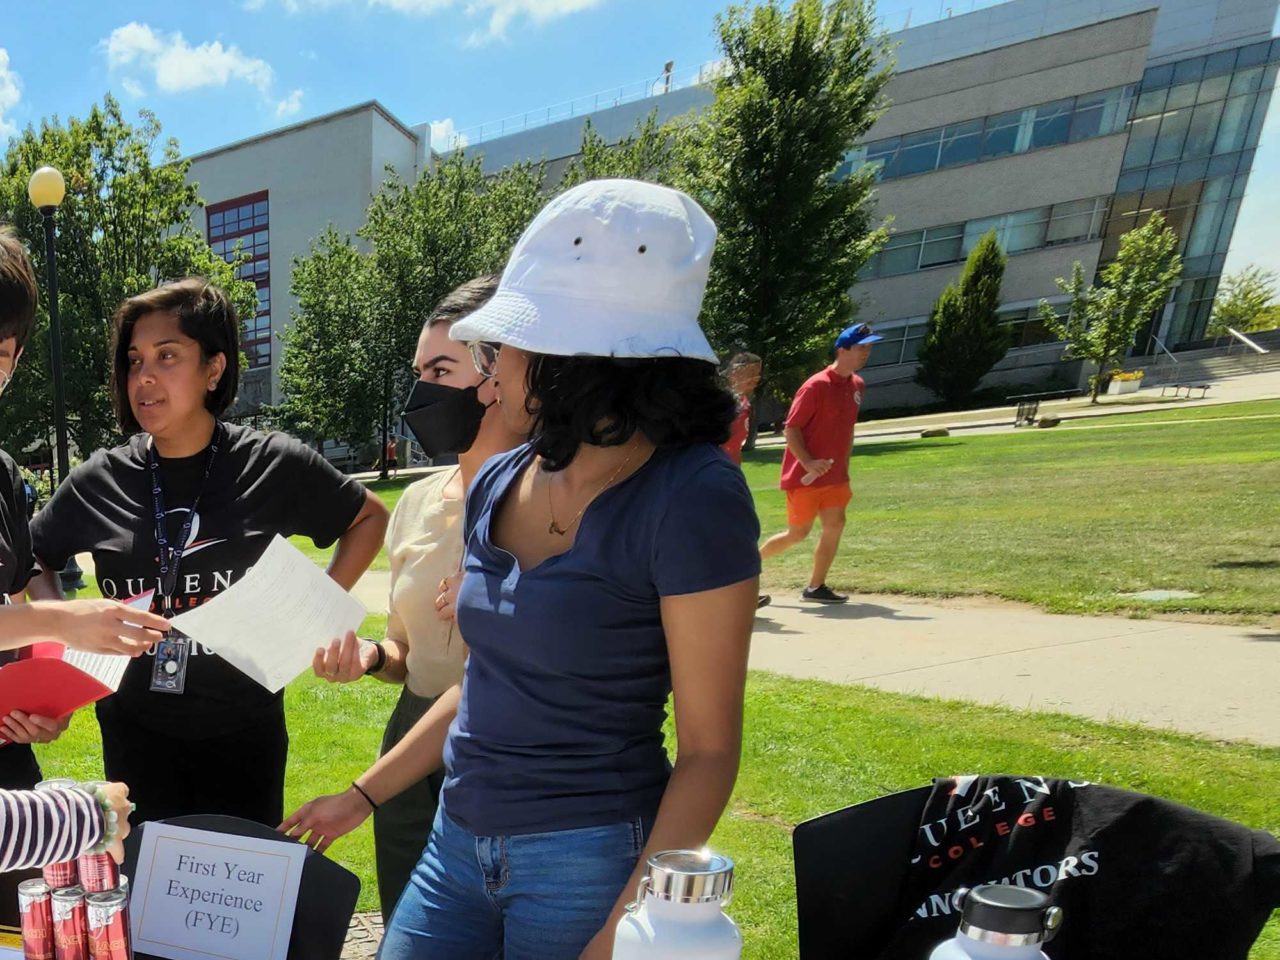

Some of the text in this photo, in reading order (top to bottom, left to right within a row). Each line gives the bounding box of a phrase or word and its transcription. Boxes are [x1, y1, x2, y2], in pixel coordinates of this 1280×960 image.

[176, 855, 265, 885] First Year
[167, 879, 263, 912] Experience
[185, 910, 240, 939] (FYE)
